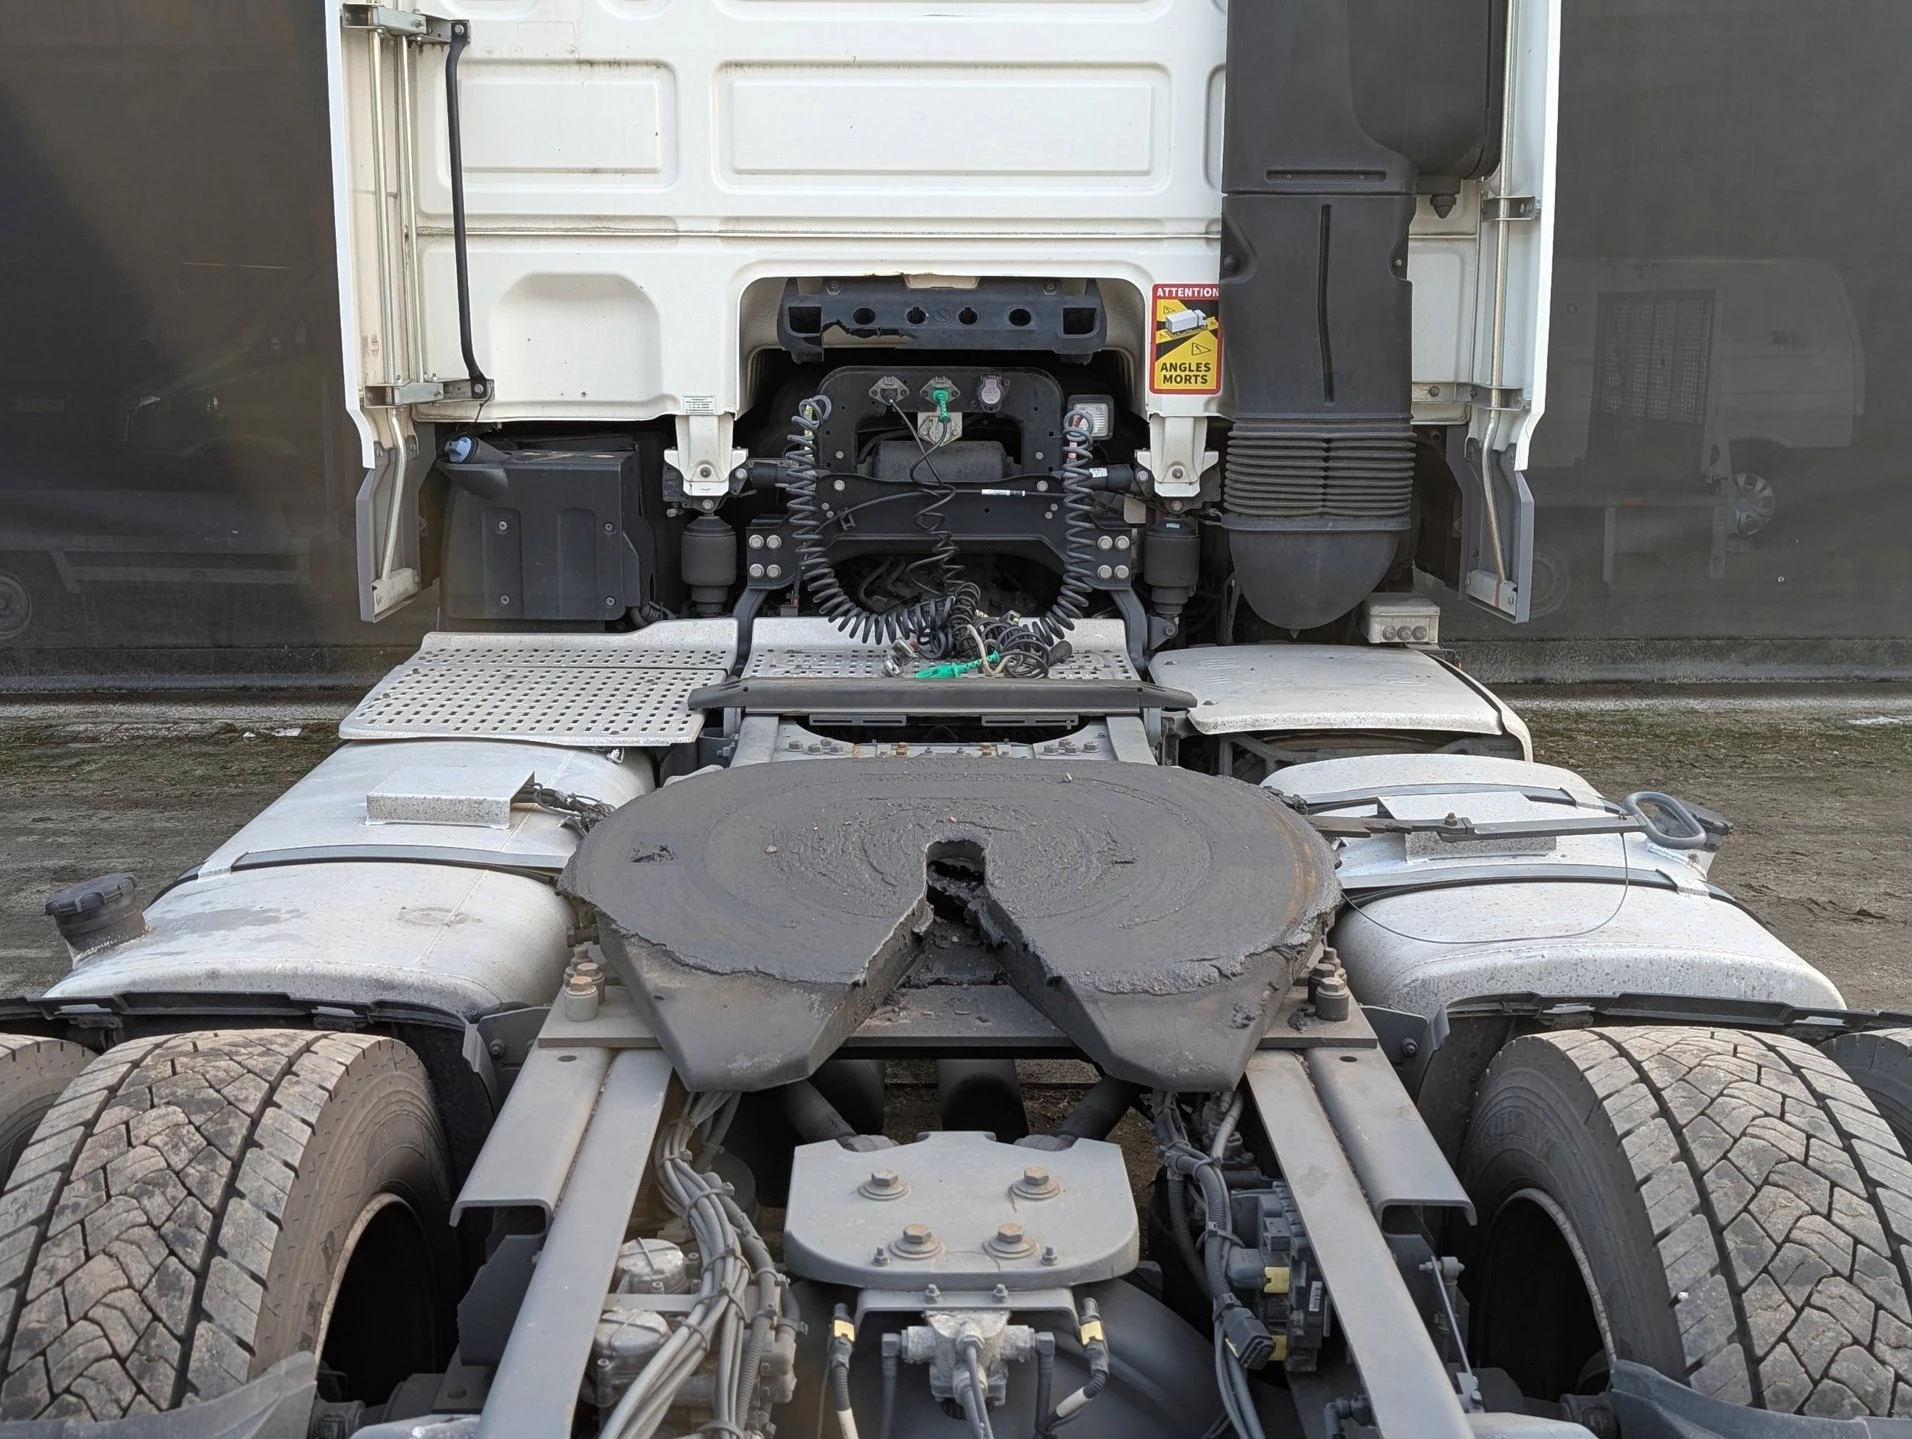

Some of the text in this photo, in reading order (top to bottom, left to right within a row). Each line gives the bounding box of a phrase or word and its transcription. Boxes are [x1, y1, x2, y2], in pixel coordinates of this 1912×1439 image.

[1157, 288, 1219, 297] ATTENTION
[1160, 362, 1211, 372] ANGLES
[1163, 374, 1208, 384] MORTS
